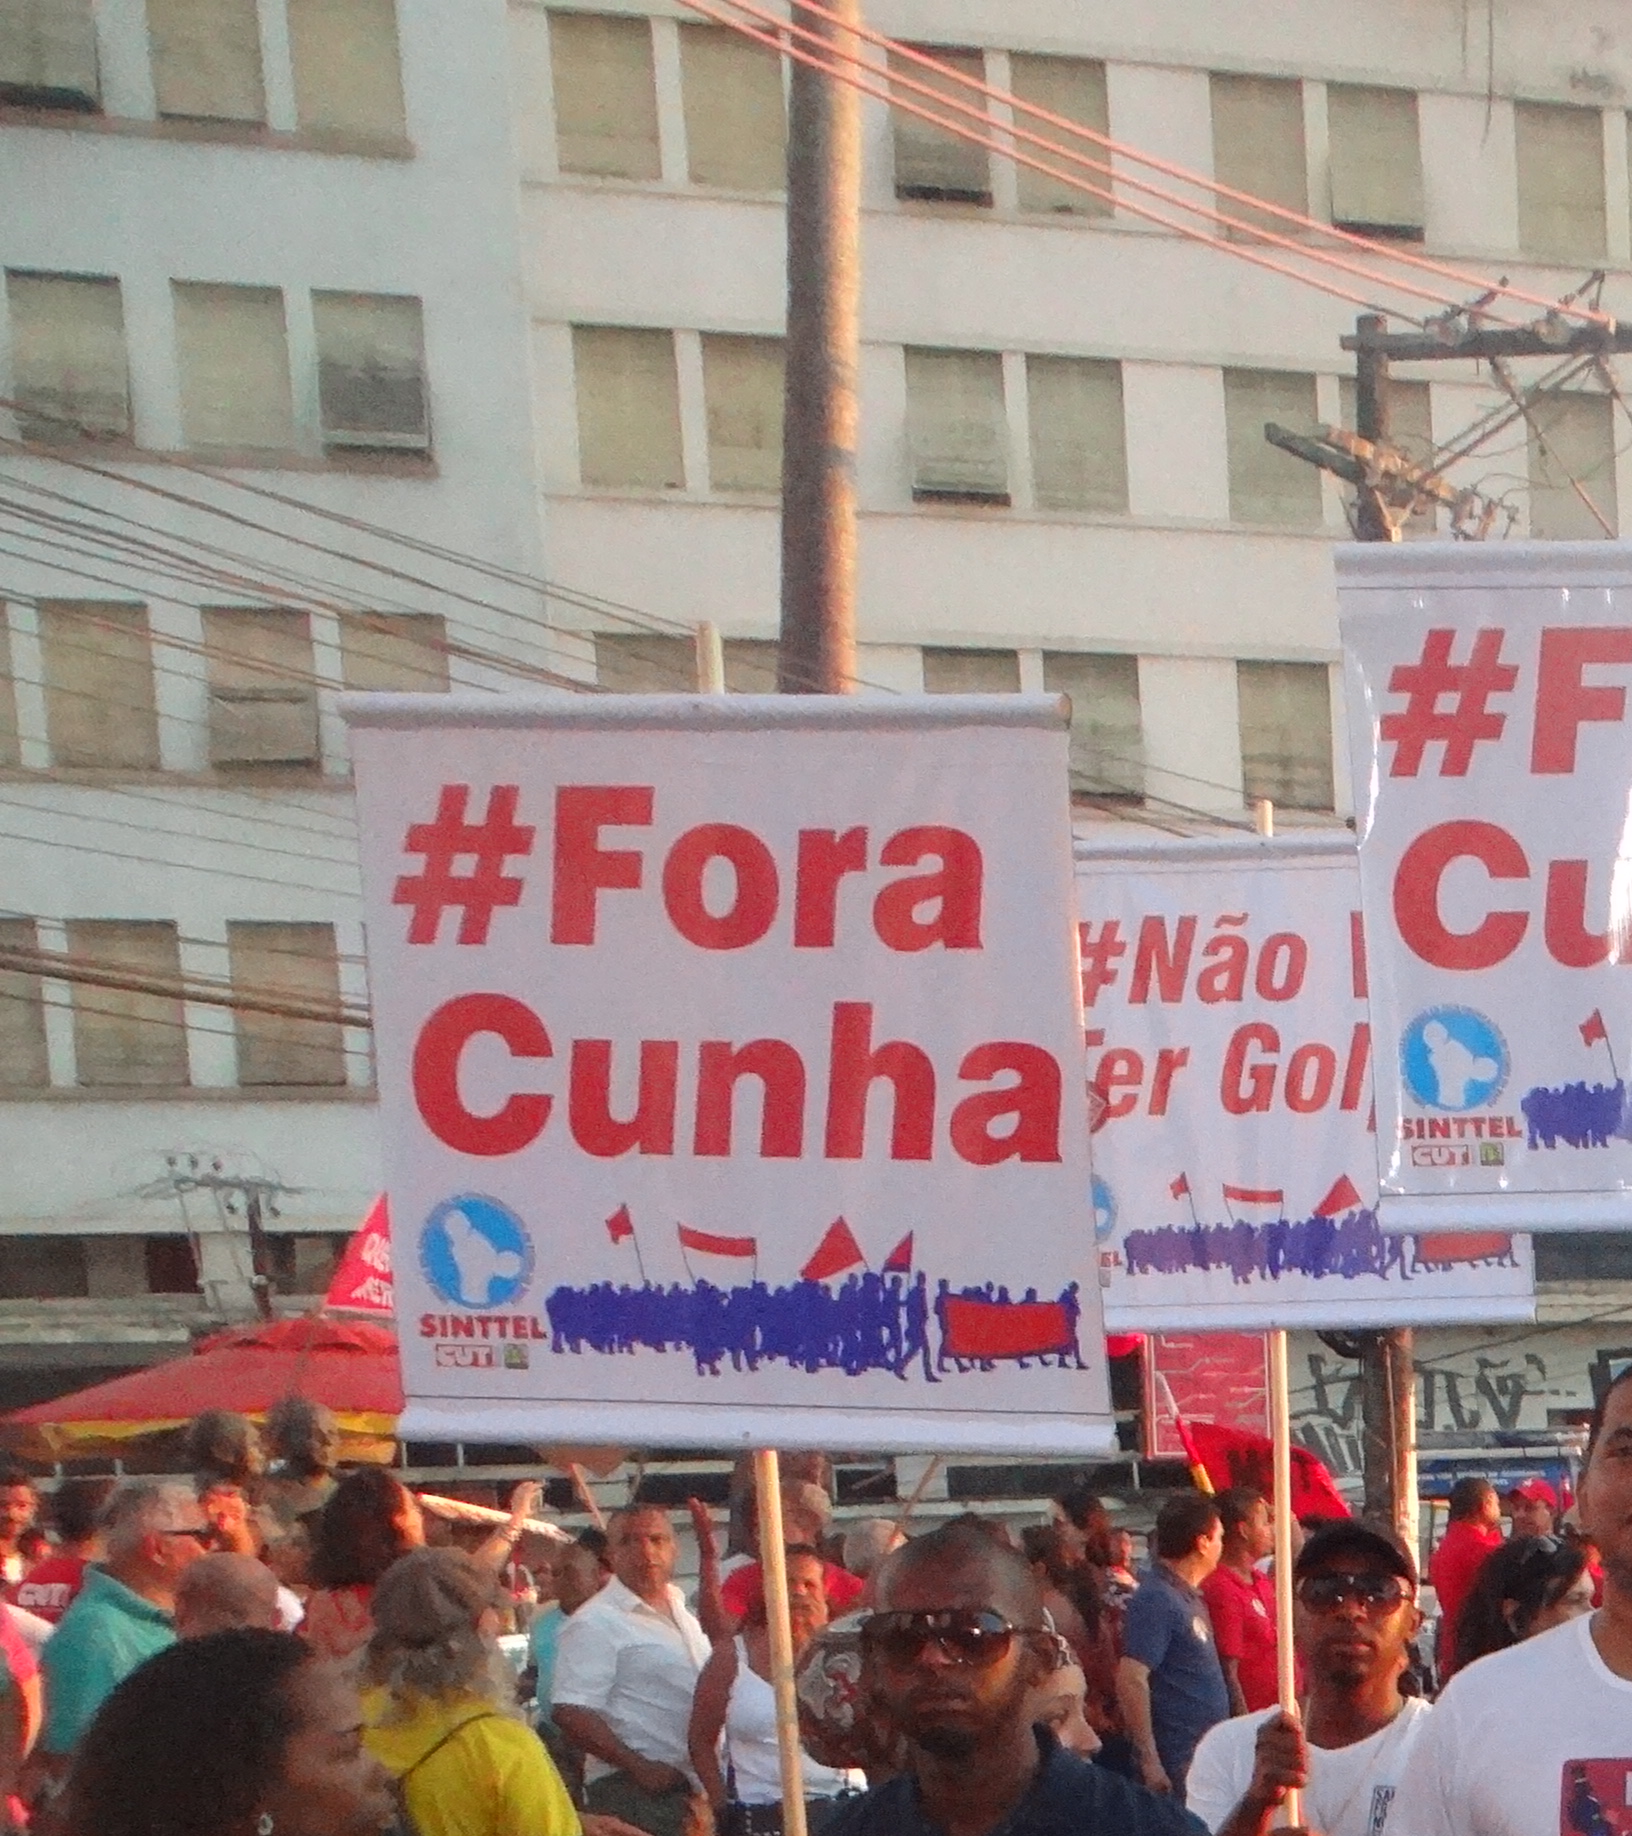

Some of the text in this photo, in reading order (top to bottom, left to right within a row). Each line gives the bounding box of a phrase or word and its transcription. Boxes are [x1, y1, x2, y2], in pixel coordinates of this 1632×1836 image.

[390, 783, 985, 952] #Fora
[411, 992, 1063, 1165] Cunha
[1402, 1116, 1523, 1140] SINTTEL
[1411, 1145, 1471, 1167] CUT
[420, 1314, 548, 1340] SINTTEL
[436, 1344, 493, 1367] CUT
